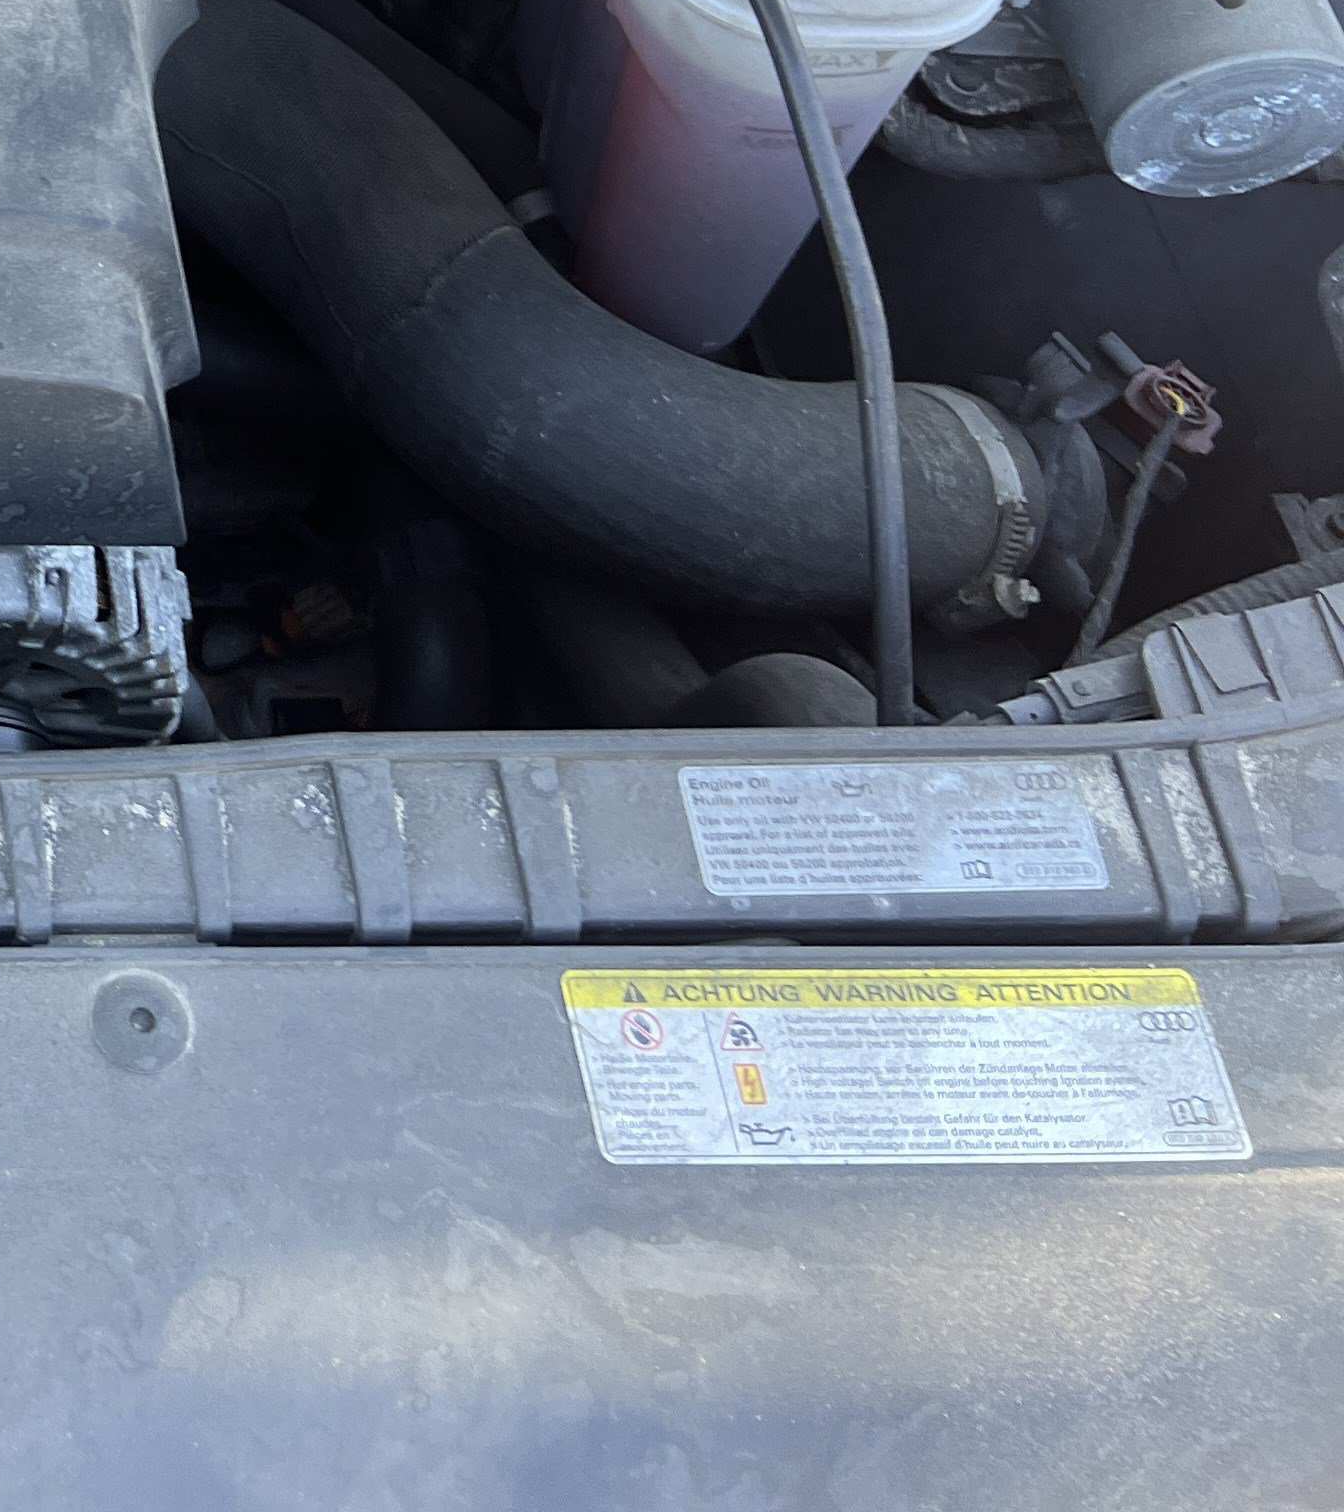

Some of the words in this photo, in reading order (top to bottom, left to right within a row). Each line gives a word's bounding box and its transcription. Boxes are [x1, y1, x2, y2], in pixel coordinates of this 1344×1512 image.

[688, 777, 743, 792] Engine
[748, 776, 772, 789] Oil
[692, 793, 734, 806] Huile
[738, 794, 800, 806] moteur
[799, 813, 821, 824] VW
[662, 983, 801, 1003] ACHTUNG
[814, 983, 959, 1003] WARNING
[974, 981, 1132, 1002] ATTENTION
[977, 1038, 1000, 1048] tout
[959, 1064, 976, 1074] der
[933, 1078, 971, 1089] engine
[972, 1076, 1008, 1087] before
[1009, 1076, 1059, 1088] touching
[936, 1090, 976, 1100] moteur
[1026, 1089, 1069, 1099] toucher
[943, 1112, 981, 1125] Gefahr
[983, 1112, 999, 1124] für
[1002, 1112, 1022, 1124] den
[872, 1128, 910, 1139] engine
[929, 1128, 949, 1137] can
[951, 1127, 995, 1138] damage
[995, 1139, 1019, 1151] peut
[1022, 1138, 1048, 1149] nuire
[1052, 1139, 1066, 1149] au
